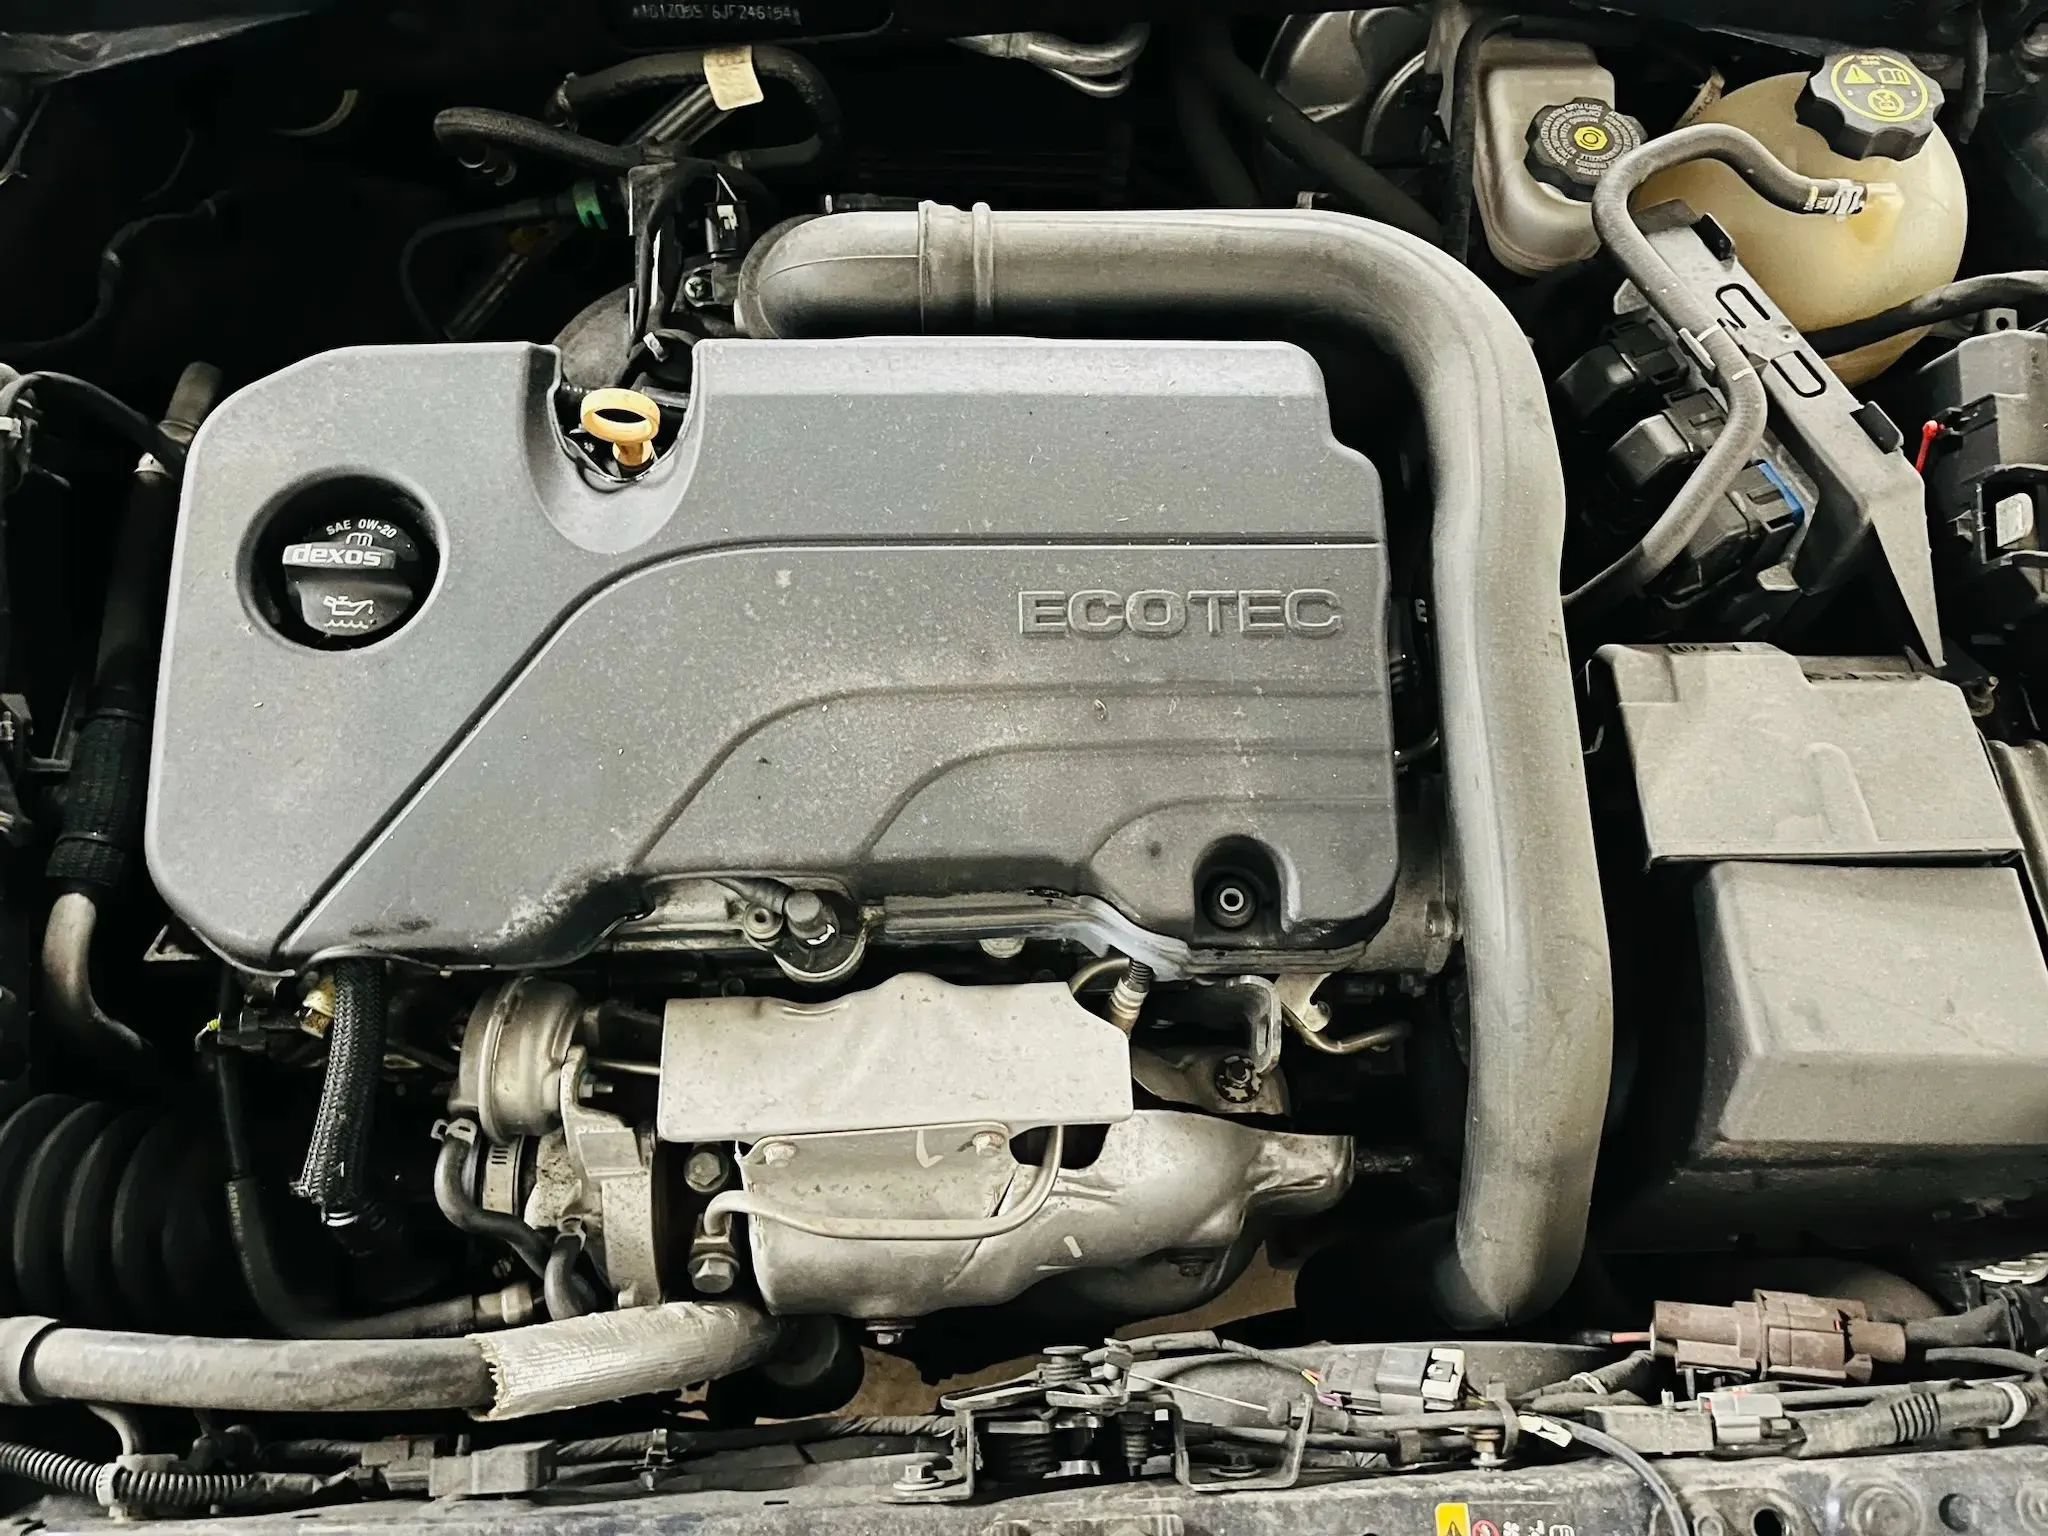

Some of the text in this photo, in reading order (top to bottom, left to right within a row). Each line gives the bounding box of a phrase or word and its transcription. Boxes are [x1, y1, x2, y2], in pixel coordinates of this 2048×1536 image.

[326, 519, 398, 537] SAE 0W-20
[292, 543, 384, 567] dexos
[1018, 588, 1343, 637] ECOTEC
